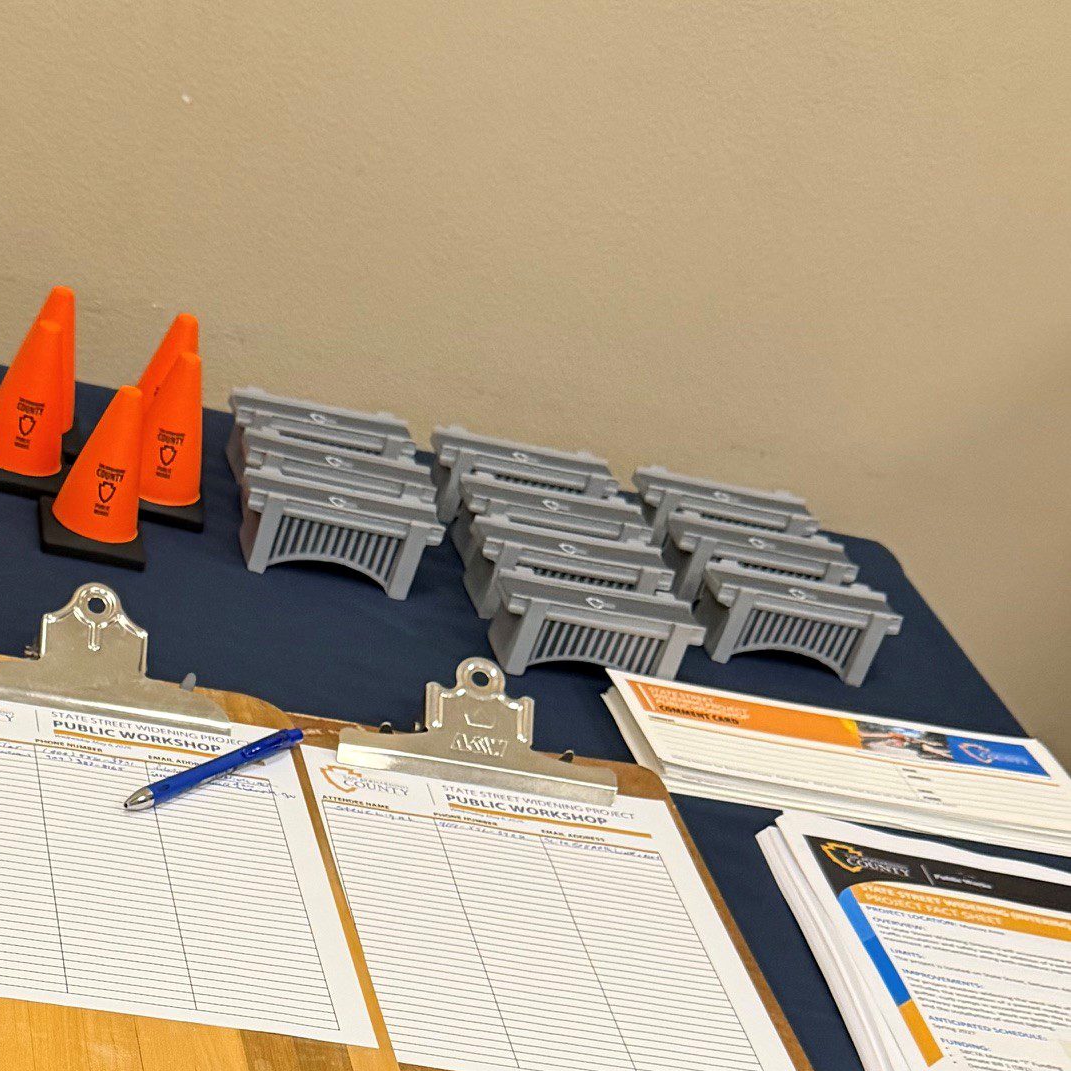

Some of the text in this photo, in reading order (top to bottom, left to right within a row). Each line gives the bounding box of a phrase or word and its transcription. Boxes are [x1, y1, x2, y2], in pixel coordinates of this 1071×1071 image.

[51, 711, 88, 723] STATE
[90, 717, 133, 730] STREET
[135, 723, 198, 739] WIDENING
[52, 719, 221, 753] PUBLIC WORKSHOP
[34, 738, 65, 747] PHONE
[66, 742, 103, 753] NUMBER
[148, 755, 173, 763] EMAIL
[343, 779, 409, 797] COUNTY
[322, 794, 390, 809] ATTENDEE NAME
[442, 784, 636, 821] STATE STREET WIDENING PROJECT
[445, 793, 507, 811] PUBLIC
[508, 804, 608, 827] WORKSHOP
[433, 812, 462, 820] PHONE
[463, 816, 498, 826] NUMBER
[541, 829, 605, 842] EMAIL ADDRESS
[865, 905, 906, 919] PROJECT
[901, 967, 984, 989] IMPROVEMENTS:
[928, 1015, 992, 1032] ANTICIPATED
[940, 1037, 991, 1052] FUNDING:
